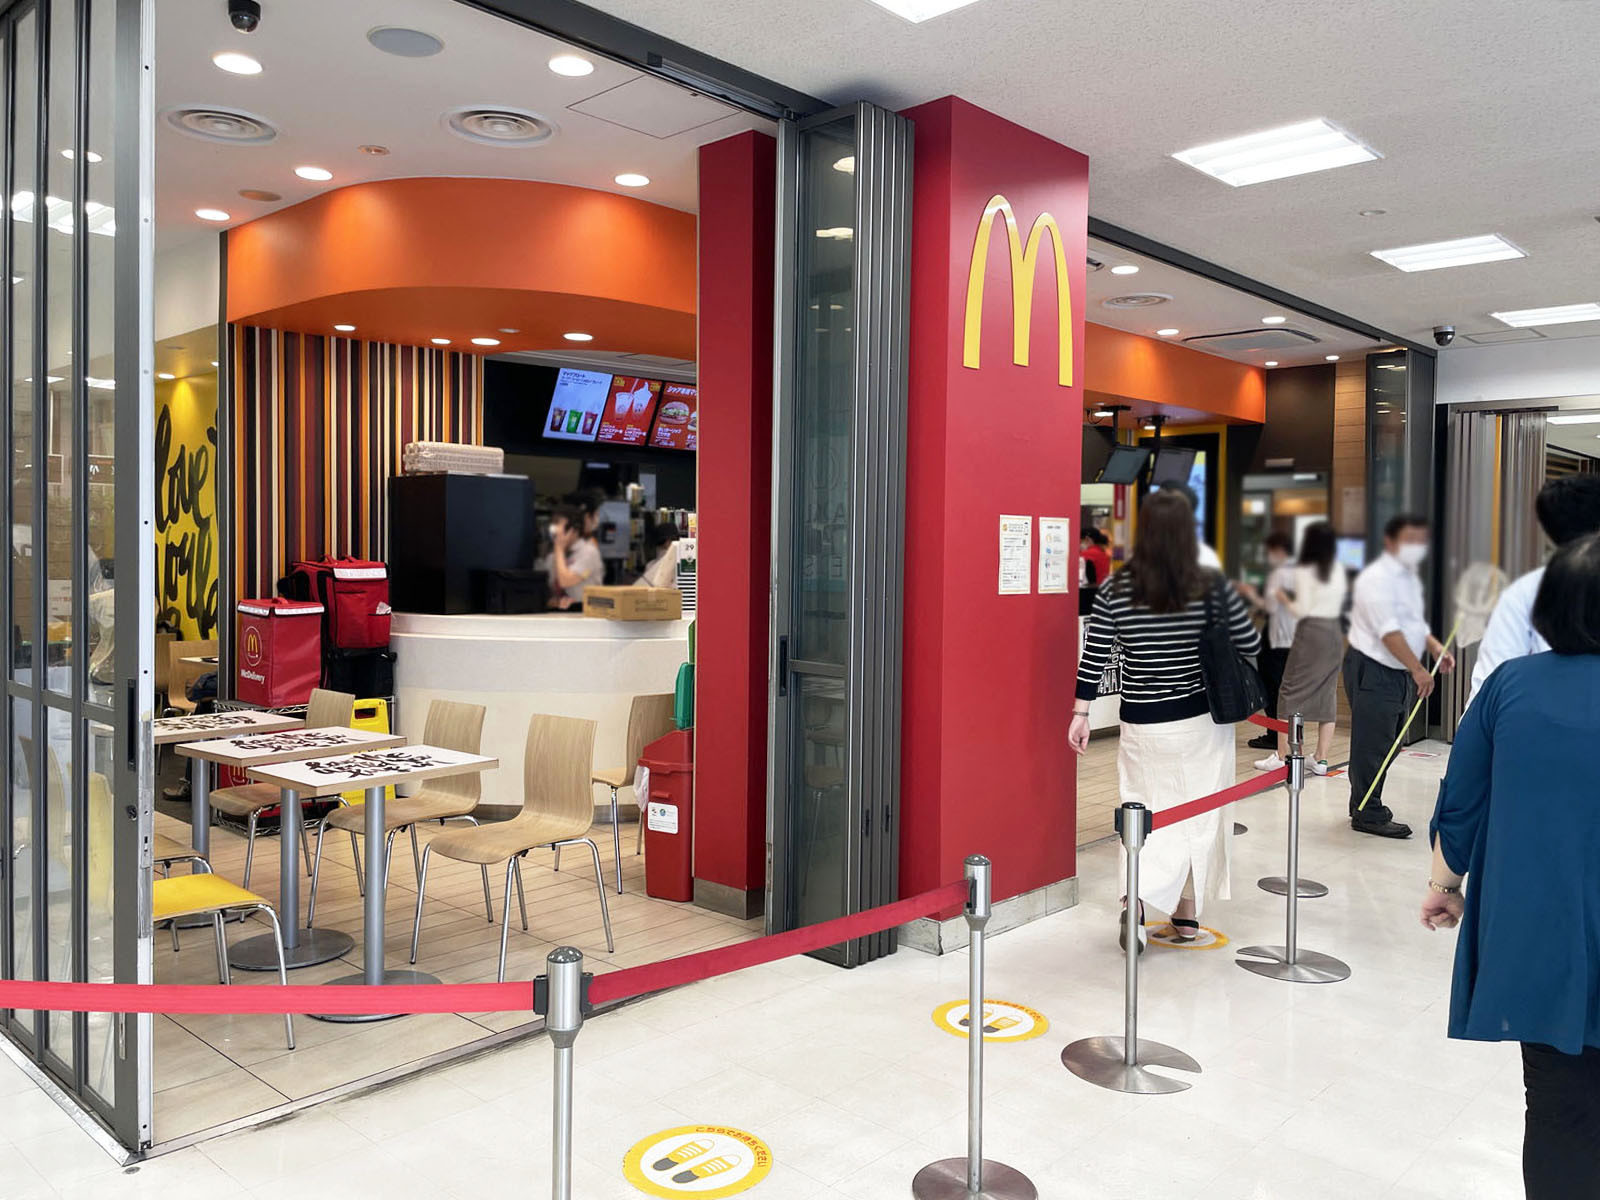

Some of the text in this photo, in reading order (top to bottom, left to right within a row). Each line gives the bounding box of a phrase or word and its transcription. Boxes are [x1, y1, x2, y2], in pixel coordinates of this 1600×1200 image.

[695, 1126, 768, 1167] こちらでお待ちください
